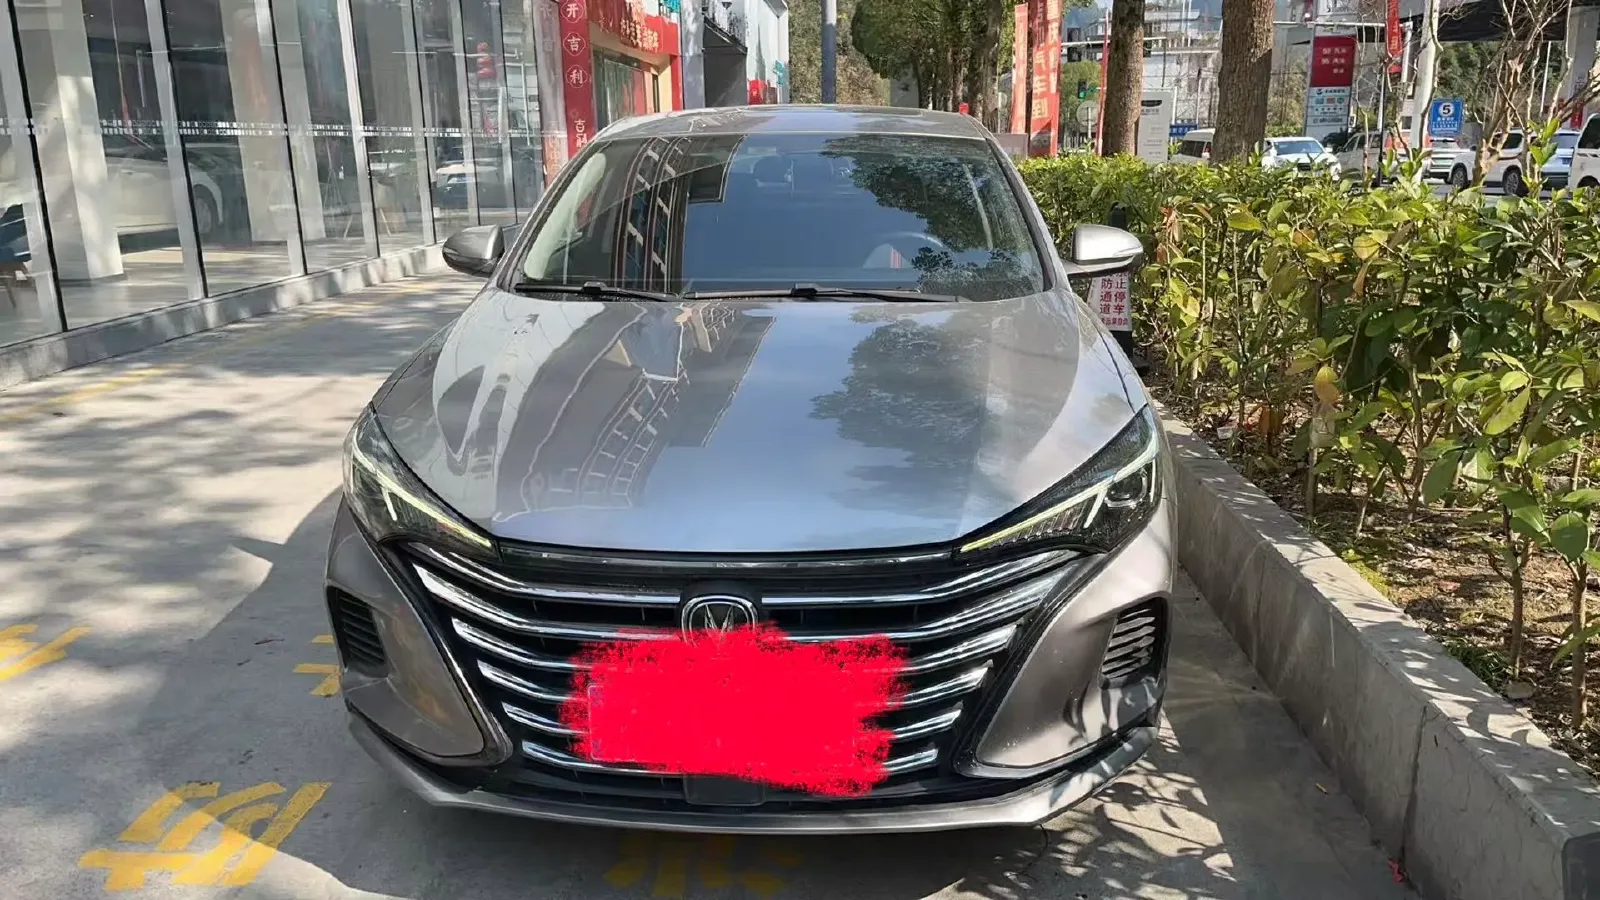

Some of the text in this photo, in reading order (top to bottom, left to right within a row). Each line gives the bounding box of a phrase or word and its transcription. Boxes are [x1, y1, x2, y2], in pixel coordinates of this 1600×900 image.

[1442, 104, 1451, 115] 5
[1100, 276, 1114, 314] 防通道
